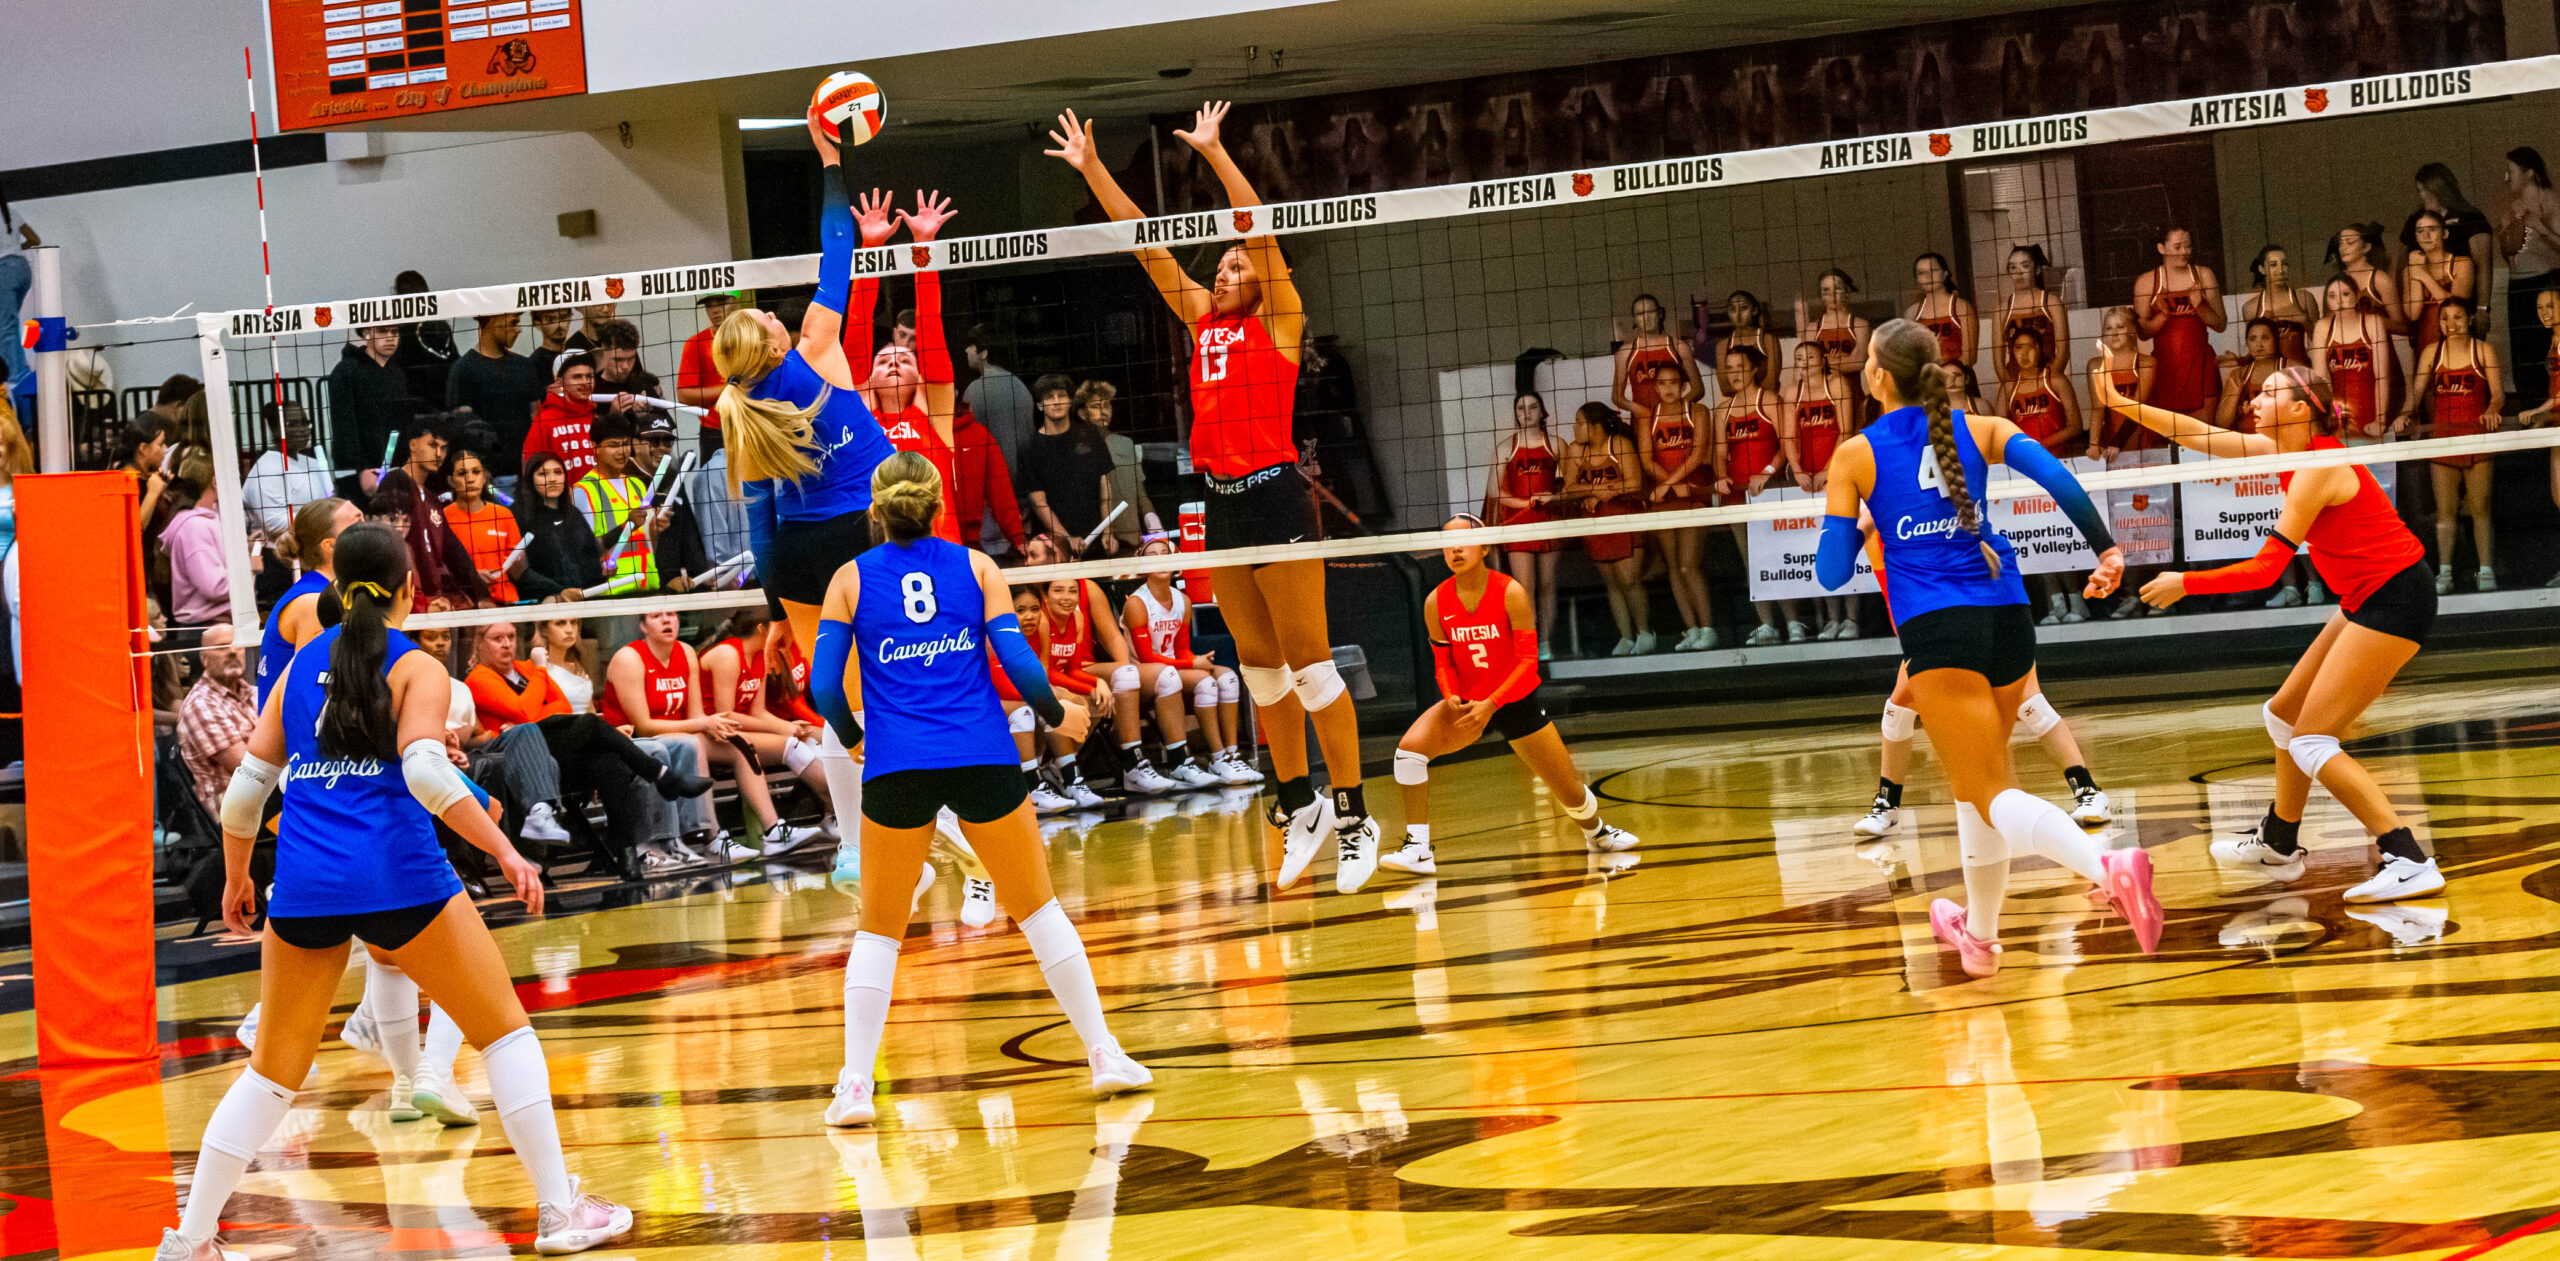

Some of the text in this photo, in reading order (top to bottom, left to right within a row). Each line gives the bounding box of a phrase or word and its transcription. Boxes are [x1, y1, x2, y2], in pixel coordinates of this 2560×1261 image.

[433, 83, 451, 105] of
[2189, 70, 2471, 127] ARTESIA BULLDOGS
[848, 103, 861, 112] L2
[1820, 115, 2087, 169] ARTESIA BULLDOGS
[1468, 158, 1723, 209] ARTESIA BULLDOGS
[1134, 197, 1377, 244] ARTESIA BULLDOGS
[854, 233, 1048, 274] ESIA BULLDOGS
[517, 266, 735, 308] ARTESIA BULLDOGS
[232, 295, 438, 336] ARTESIA BULLDOGS
[1200, 345, 1228, 382] 13
[552, 423, 581, 438] JUST
[1215, 480, 1246, 495] NIKE
[1247, 467, 1282, 488] PRO
[1918, 444, 1951, 498] 4
[2234, 480, 2281, 498] Miller
[2013, 498, 2058, 516] Miller
[2218, 507, 2282, 525] Supporti
[1773, 516, 1817, 532] Mark
[1999, 524, 2074, 543] Supporting
[2194, 526, 2250, 541] Bulldog
[2032, 538, 2090, 555] Volleyba
[1760, 568, 1812, 581] Bulldog
[901, 571, 939, 625] 8
[1451, 623, 1500, 642] ARTESIA
[879, 626, 975, 667] Cavegirls
[1468, 643, 1489, 669] 2
[664, 692, 684, 716] 17
[287, 752, 384, 790] Cavegirls
